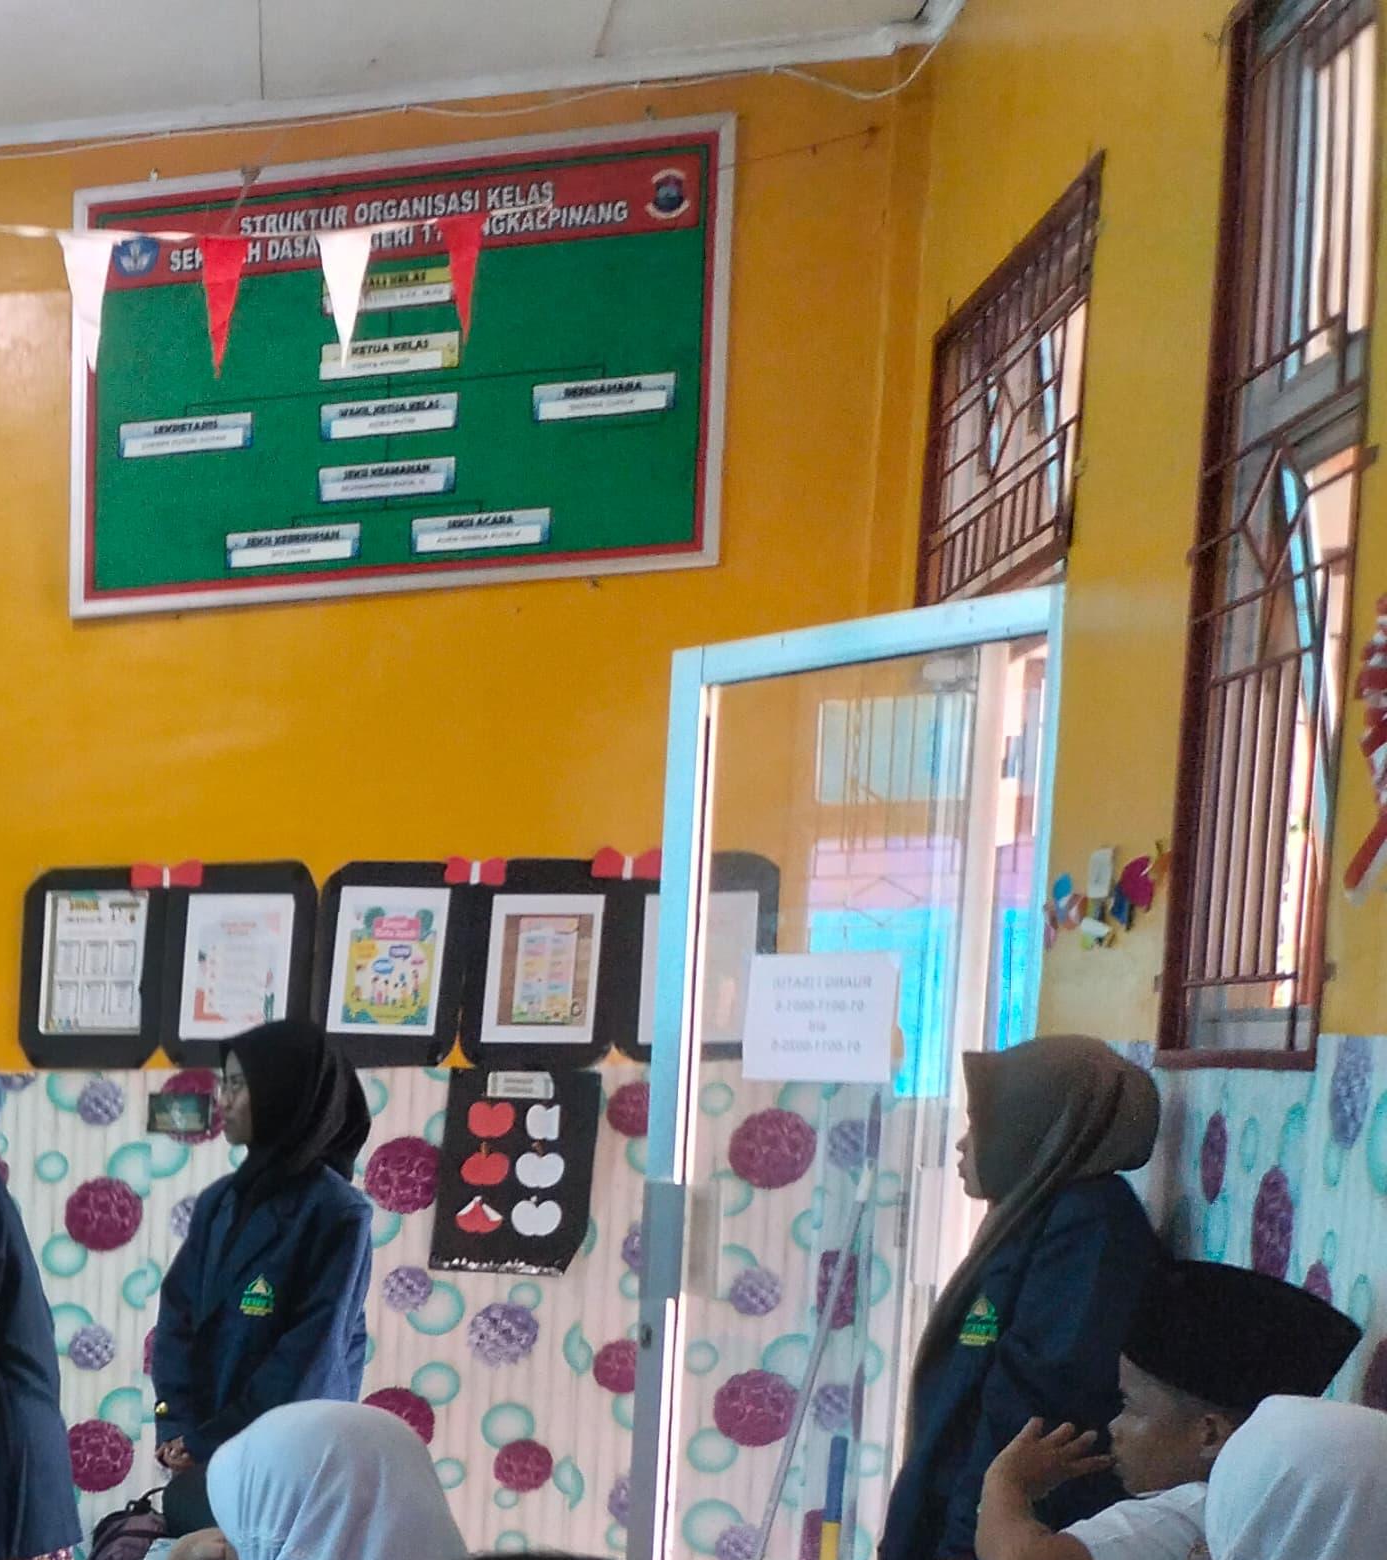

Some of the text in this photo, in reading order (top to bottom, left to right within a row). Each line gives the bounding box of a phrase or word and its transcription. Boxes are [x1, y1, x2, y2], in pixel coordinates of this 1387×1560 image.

[240, 181, 555, 236] STRUKTUR ORGANISASI KELAS
[267, 234, 323, 263] DASA
[482, 200, 629, 236] GKALPINANG
